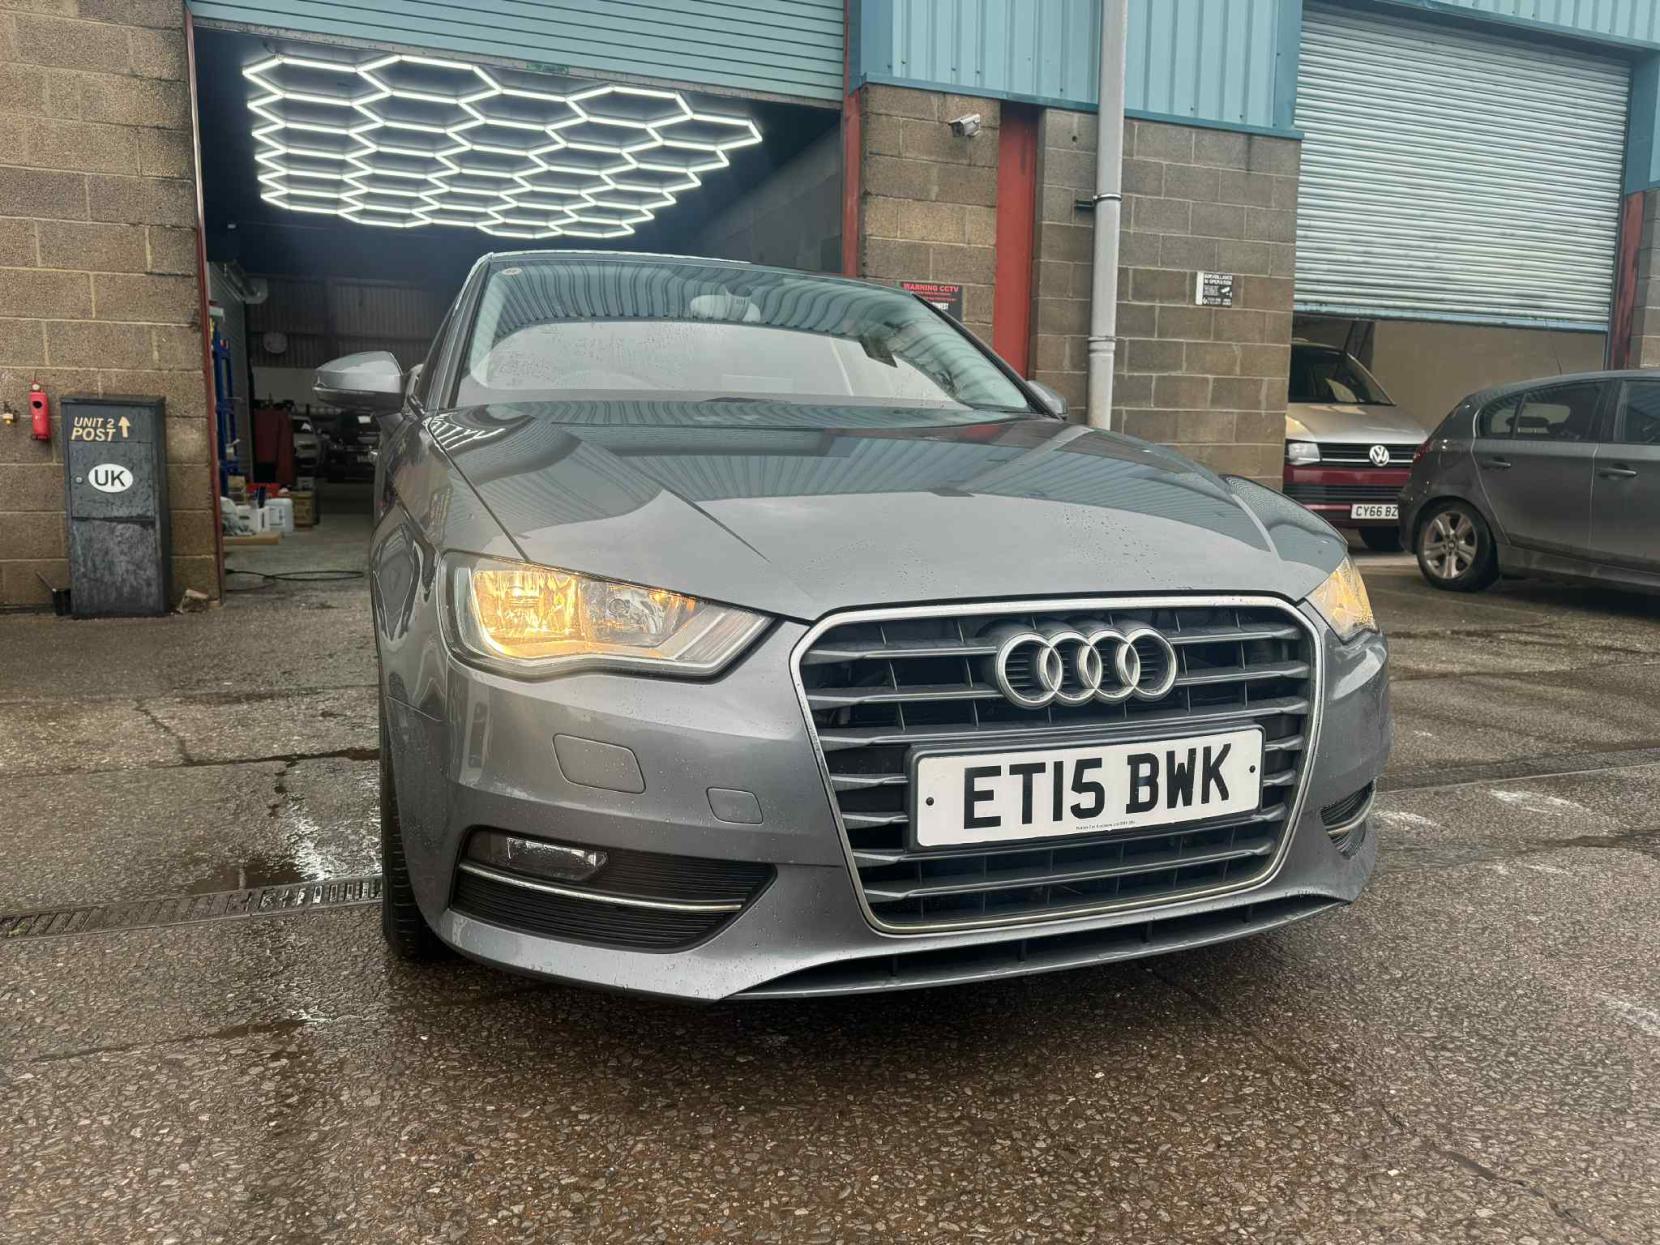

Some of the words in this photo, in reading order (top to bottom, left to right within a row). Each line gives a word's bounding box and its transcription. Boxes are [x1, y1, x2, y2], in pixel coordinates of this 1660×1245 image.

[903, 283, 938, 292] WARNING
[74, 416, 103, 427] UNIT
[106, 418, 115, 428] 2
[71, 427, 116, 442] POST
[94, 469, 126, 487] UK
[1355, 506, 1383, 517] CY66
[963, 757, 1105, 830] ET15
[1125, 742, 1232, 814] BWK
